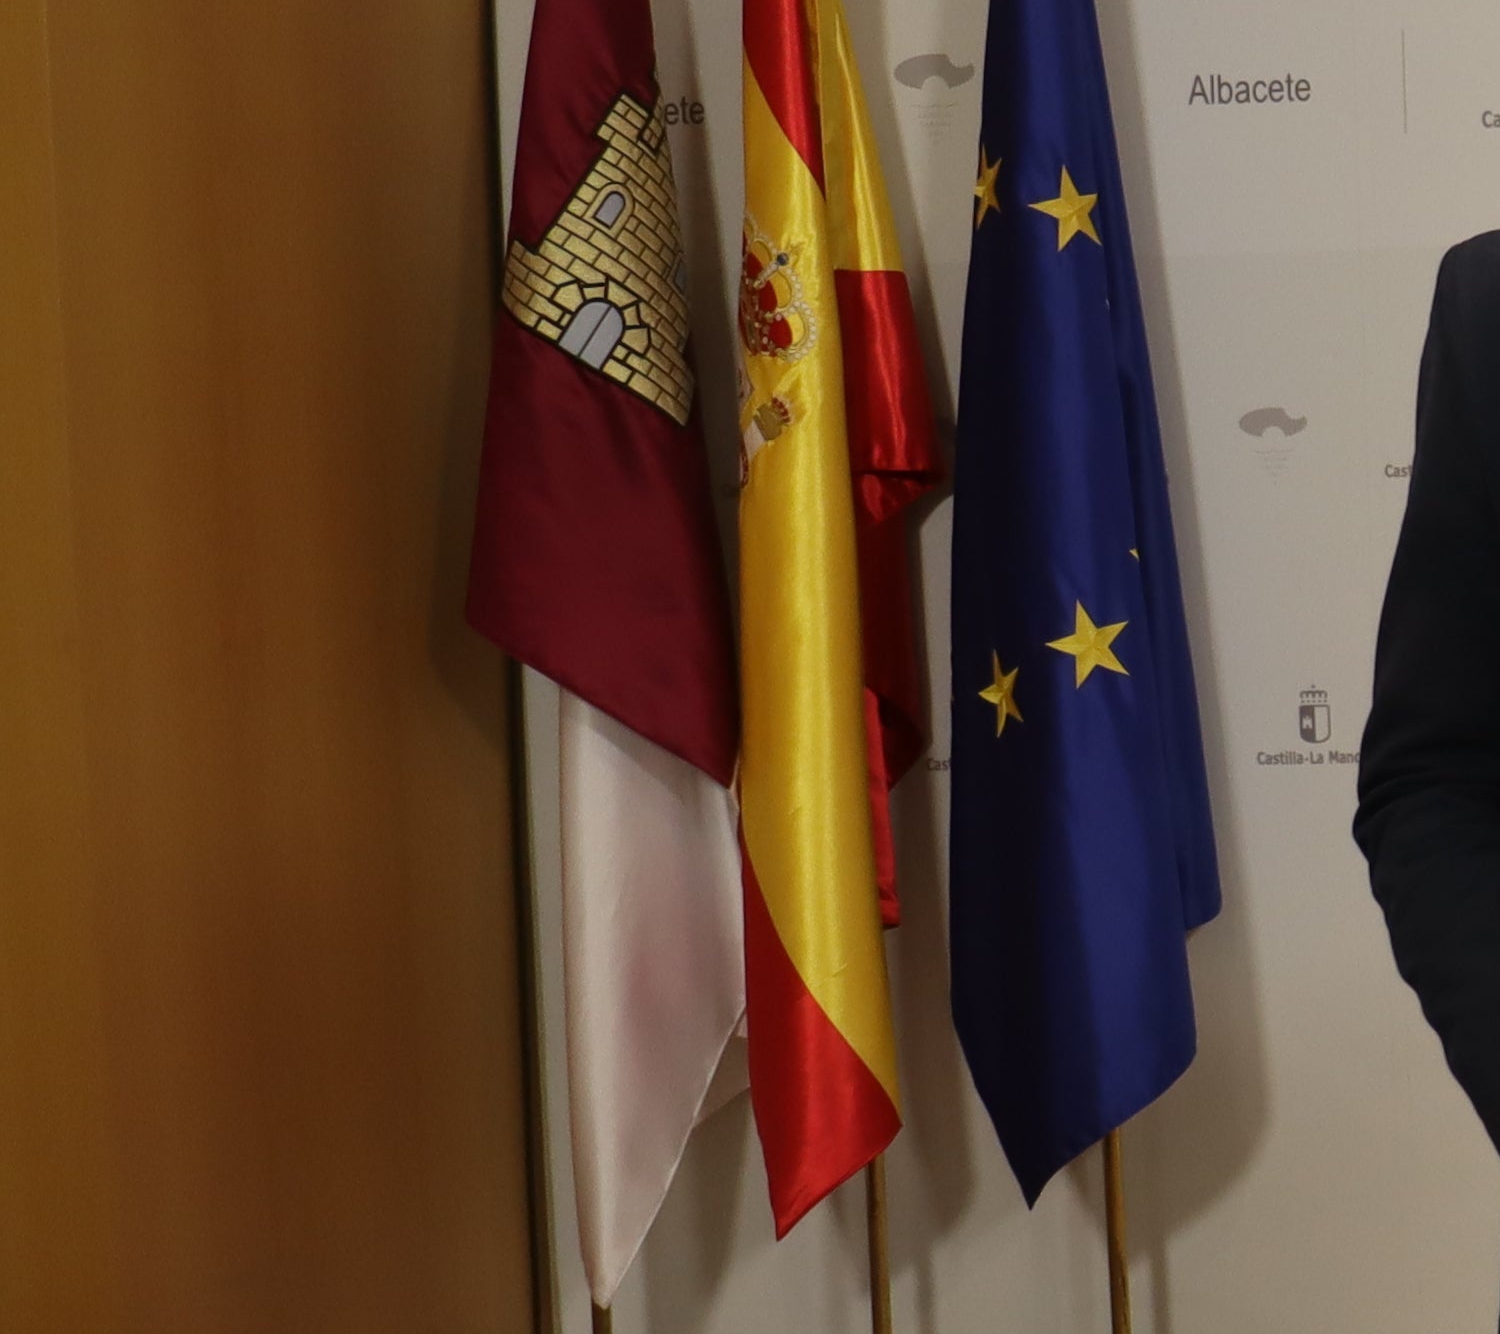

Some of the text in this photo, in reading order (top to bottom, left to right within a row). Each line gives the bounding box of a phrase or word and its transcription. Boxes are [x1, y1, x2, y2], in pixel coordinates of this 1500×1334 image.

[1187, 72, 1312, 107] Albacete
[1256, 749, 1362, 767] Castilla-La Manc
